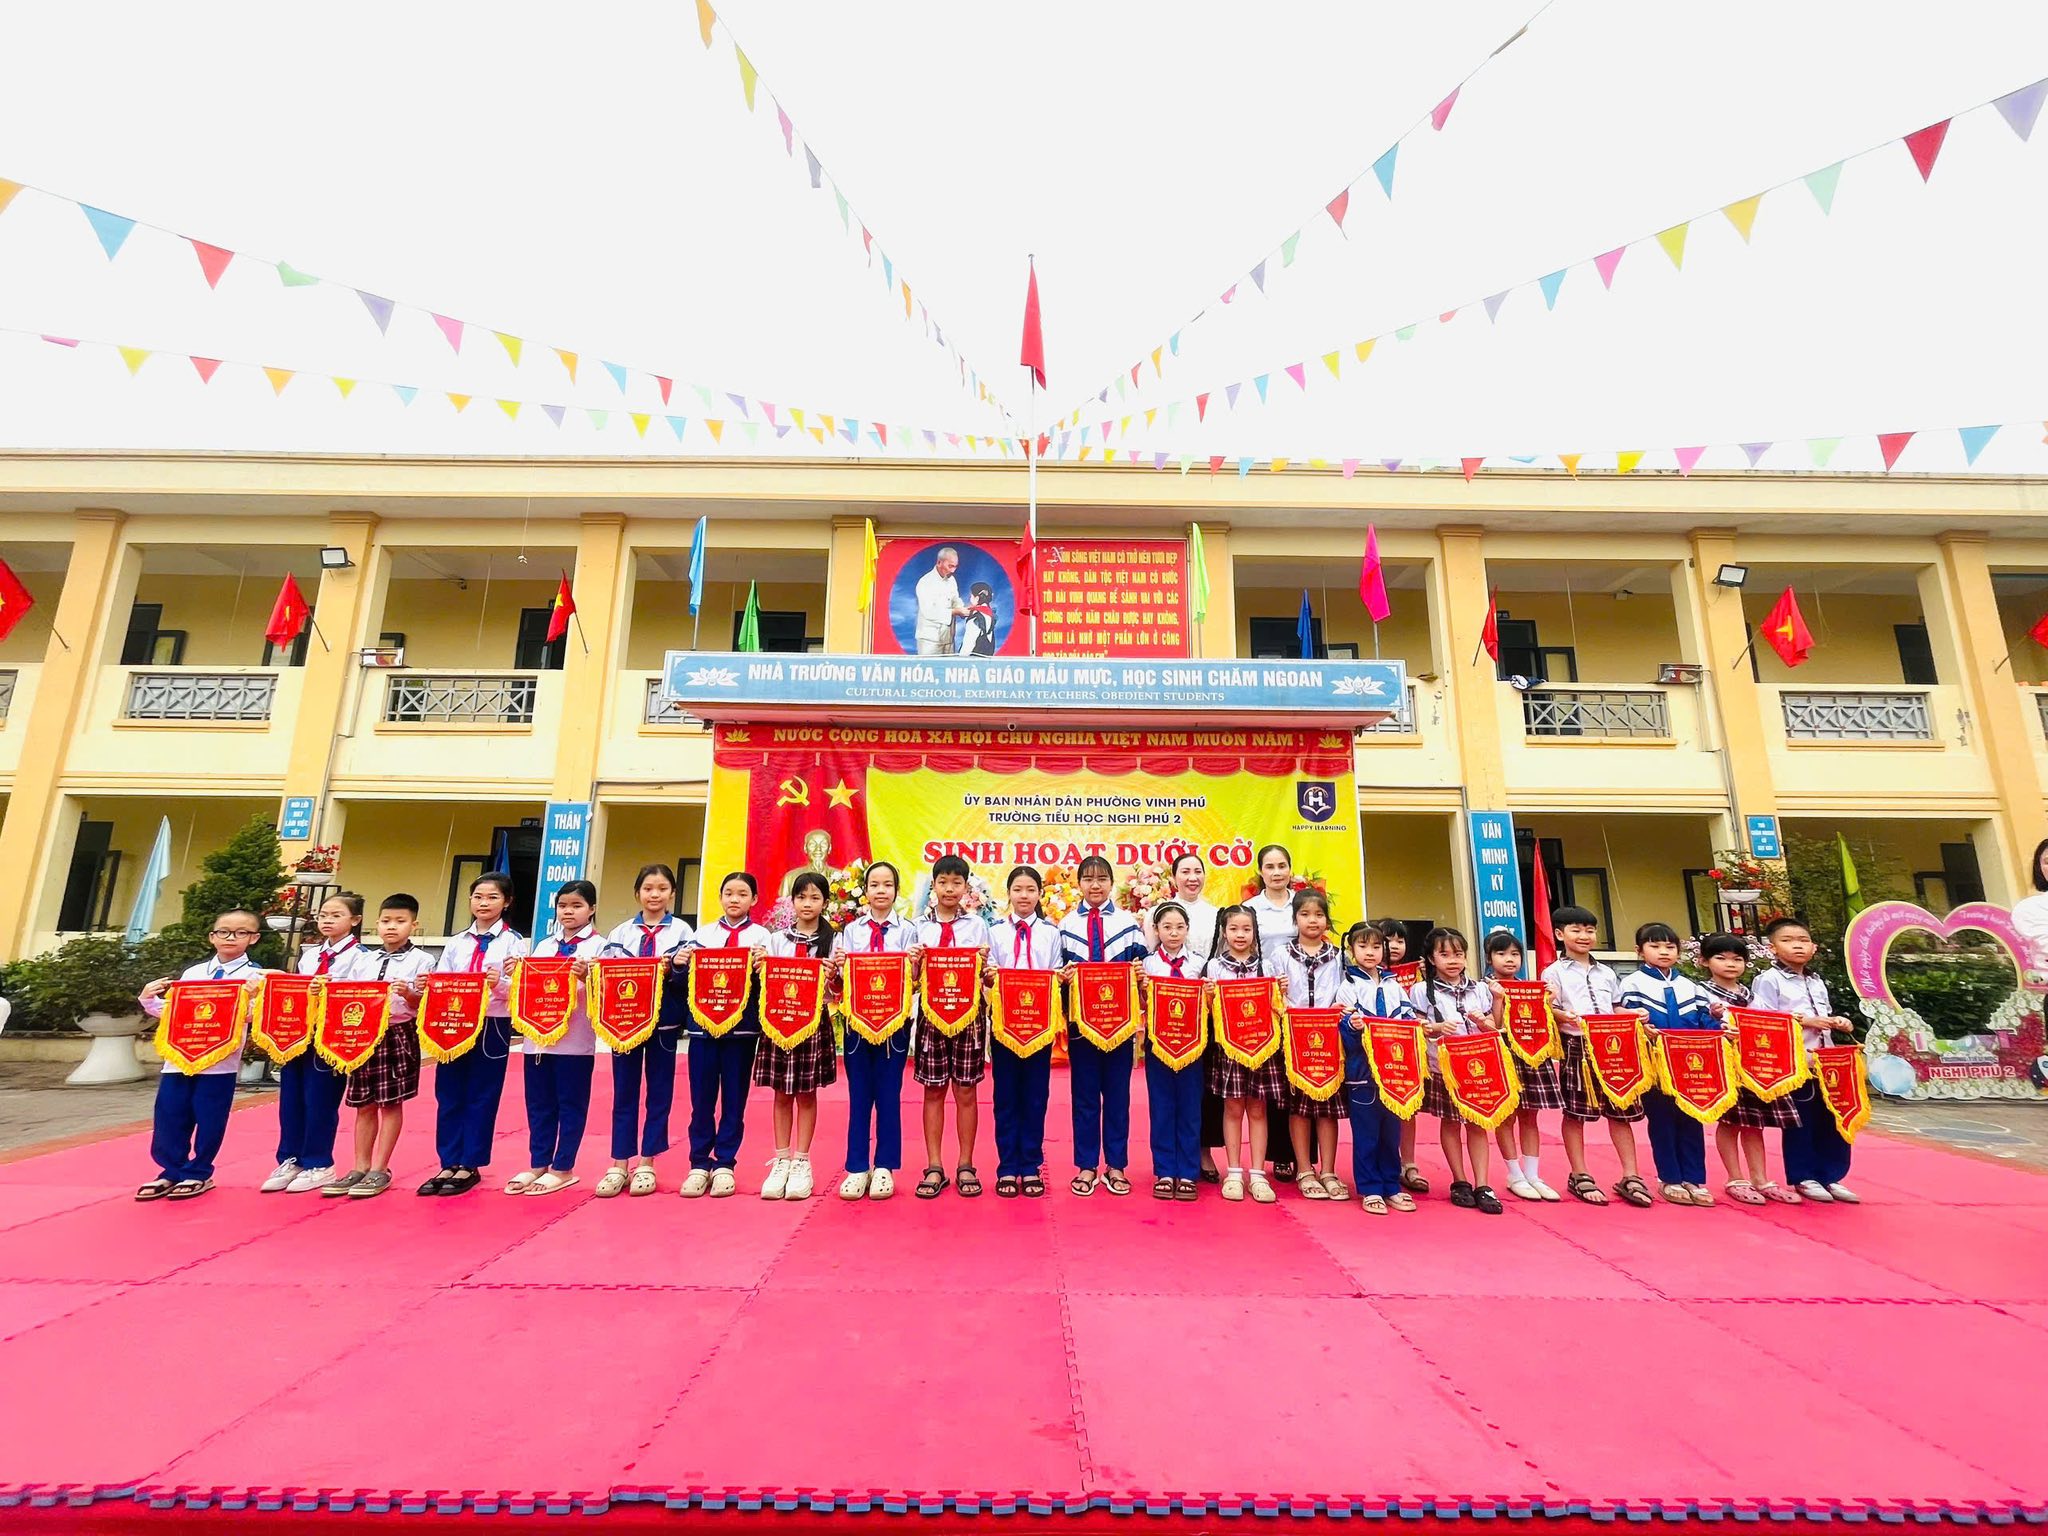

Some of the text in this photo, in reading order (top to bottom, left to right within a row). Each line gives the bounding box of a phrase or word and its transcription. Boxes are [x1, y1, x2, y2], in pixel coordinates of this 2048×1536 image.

[748, 660, 1323, 689] NHÀ TRƯỜNG VĂN HÓA, NHÀ GIÁO MẪU MỰC, HỌC SINH CHĂM NGOAN
[845, 687, 907, 697] CULTURAL
[965, 690, 1035, 699] EXEMPLARY
[1101, 691, 1161, 700] OBEDIENT
[1163, 692, 1225, 701] STUDENTS
[1147, 733, 1188, 746] NAM
[964, 793, 1206, 807] ỦY BAN NHÂN DÂN PHƯỜNG VINH PHÚ
[554, 811, 581, 830] THÂN
[989, 808, 1181, 826] TRƯỜNG TIỂU HỌC NGHI PHÚ 2
[1481, 819, 1502, 839] VĂN
[550, 836, 580, 859] THIỆN
[924, 837, 1253, 871] SINH HOẠT DƯỚI CỜ
[1481, 848, 1508, 865] MINH
[546, 862, 576, 882] ĐOÀN
[1490, 868, 1504, 891] KỶ
[1483, 899, 1517, 918] CƯƠNG
[1929, 1066, 1968, 1079] NGHI
[2003, 1065, 2017, 1078] 2
